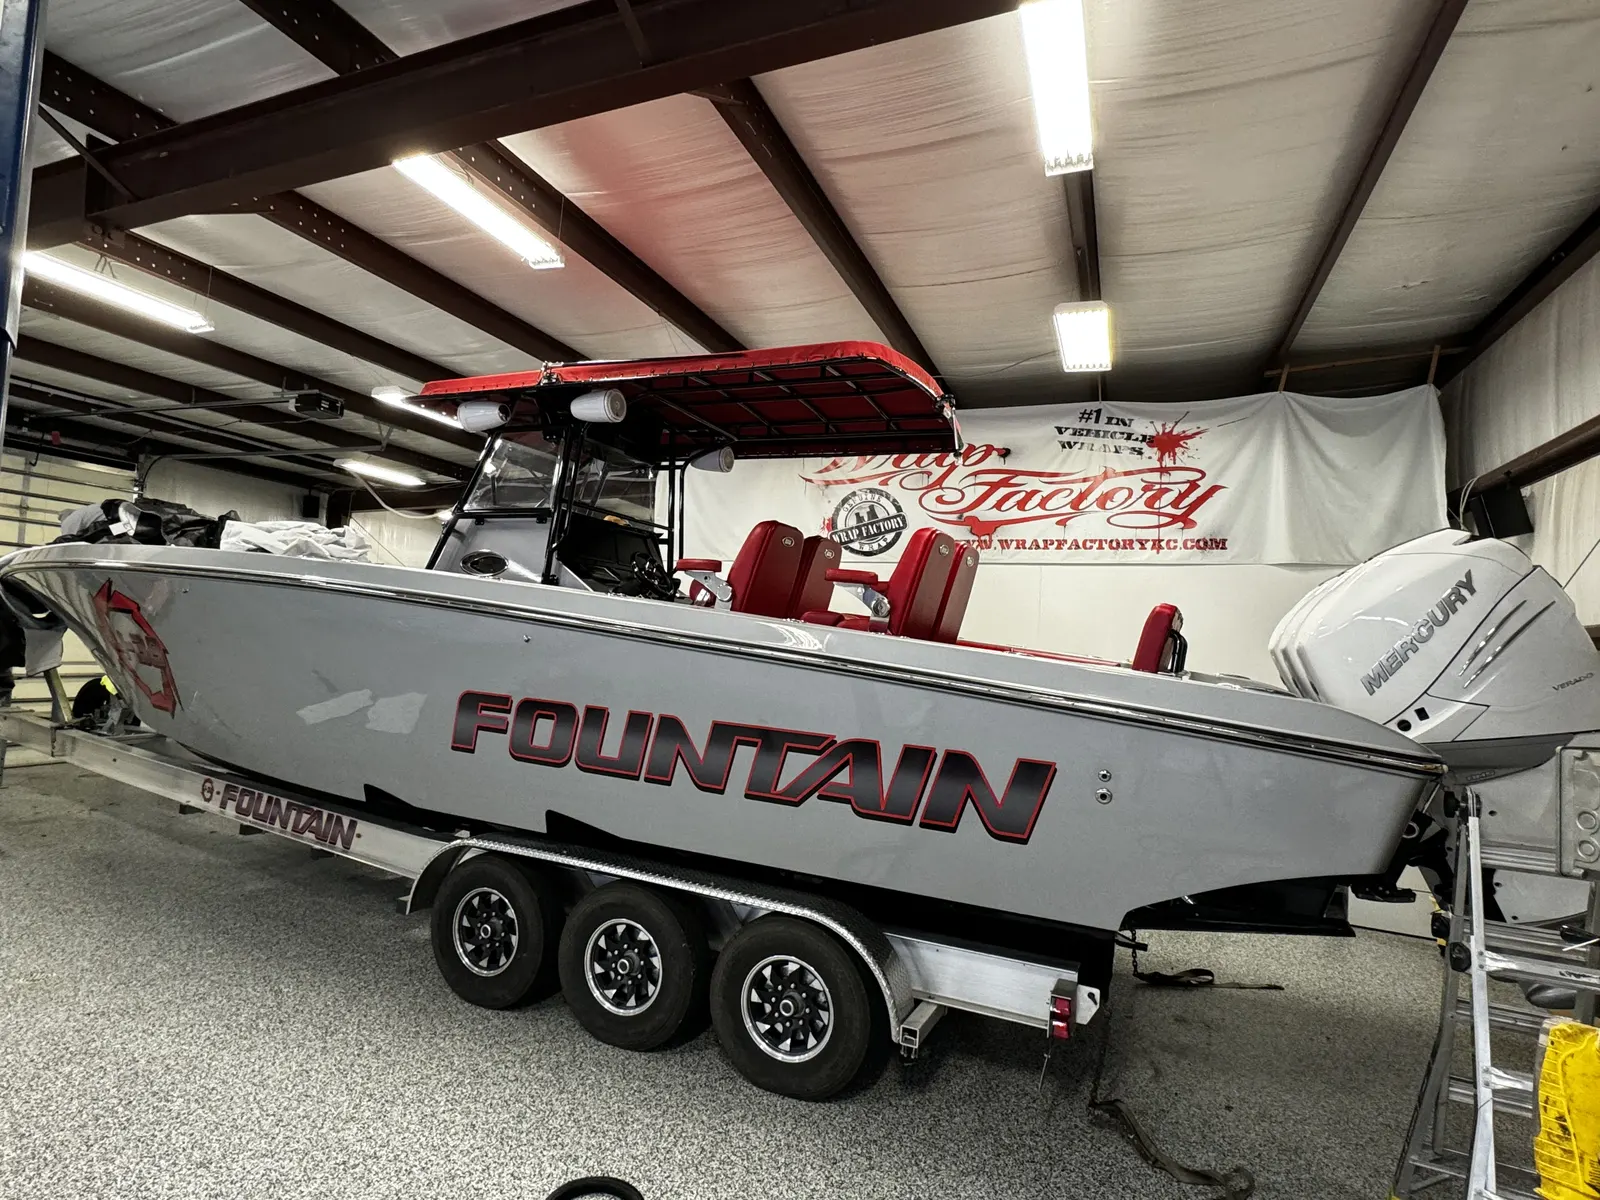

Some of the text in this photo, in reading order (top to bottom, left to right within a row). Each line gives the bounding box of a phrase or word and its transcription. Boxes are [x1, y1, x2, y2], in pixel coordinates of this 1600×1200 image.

[1054, 426, 1155, 444] VEHICLE
[1078, 408, 1135, 428] #1 IN
[1057, 440, 1144, 456] WRAPS
[916, 466, 1228, 529] Factory
[831, 515, 905, 544] WRAP FACTORY
[1360, 569, 1477, 696] MERCURY
[451, 689, 1058, 845] FOUNTAIN
[219, 783, 358, 850] FOUNTAIN
